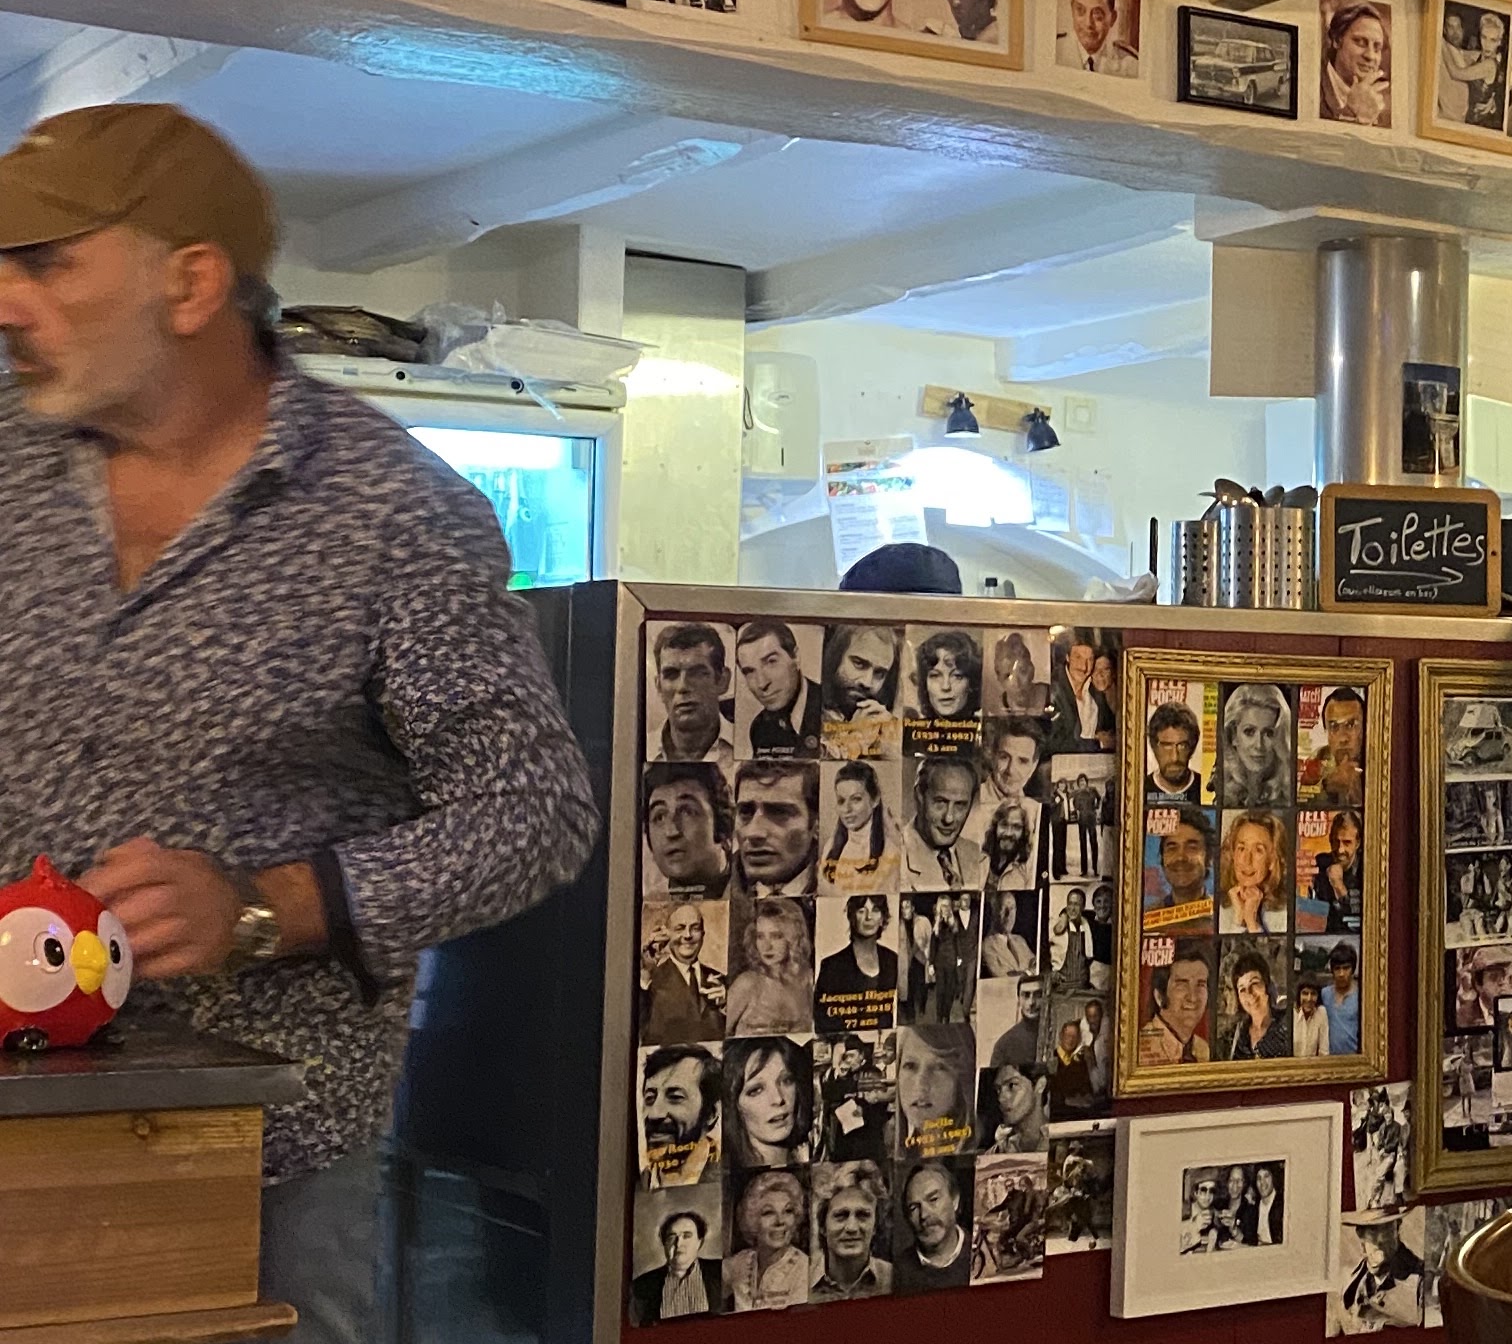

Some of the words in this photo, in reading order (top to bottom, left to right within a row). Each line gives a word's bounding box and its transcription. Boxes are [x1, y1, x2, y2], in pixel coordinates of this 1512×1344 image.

[1338, 512, 1485, 566] Toilettes
[1149, 688, 1187, 707] POCHE
[1147, 817, 1178, 834] POCHE
[1298, 821, 1328, 837] POCHE
[1141, 949, 1174, 967] POCHE
[819, 992, 863, 1003] Jacques
[845, 1018, 858, 1029] 77
[860, 1017, 878, 1027] ans
